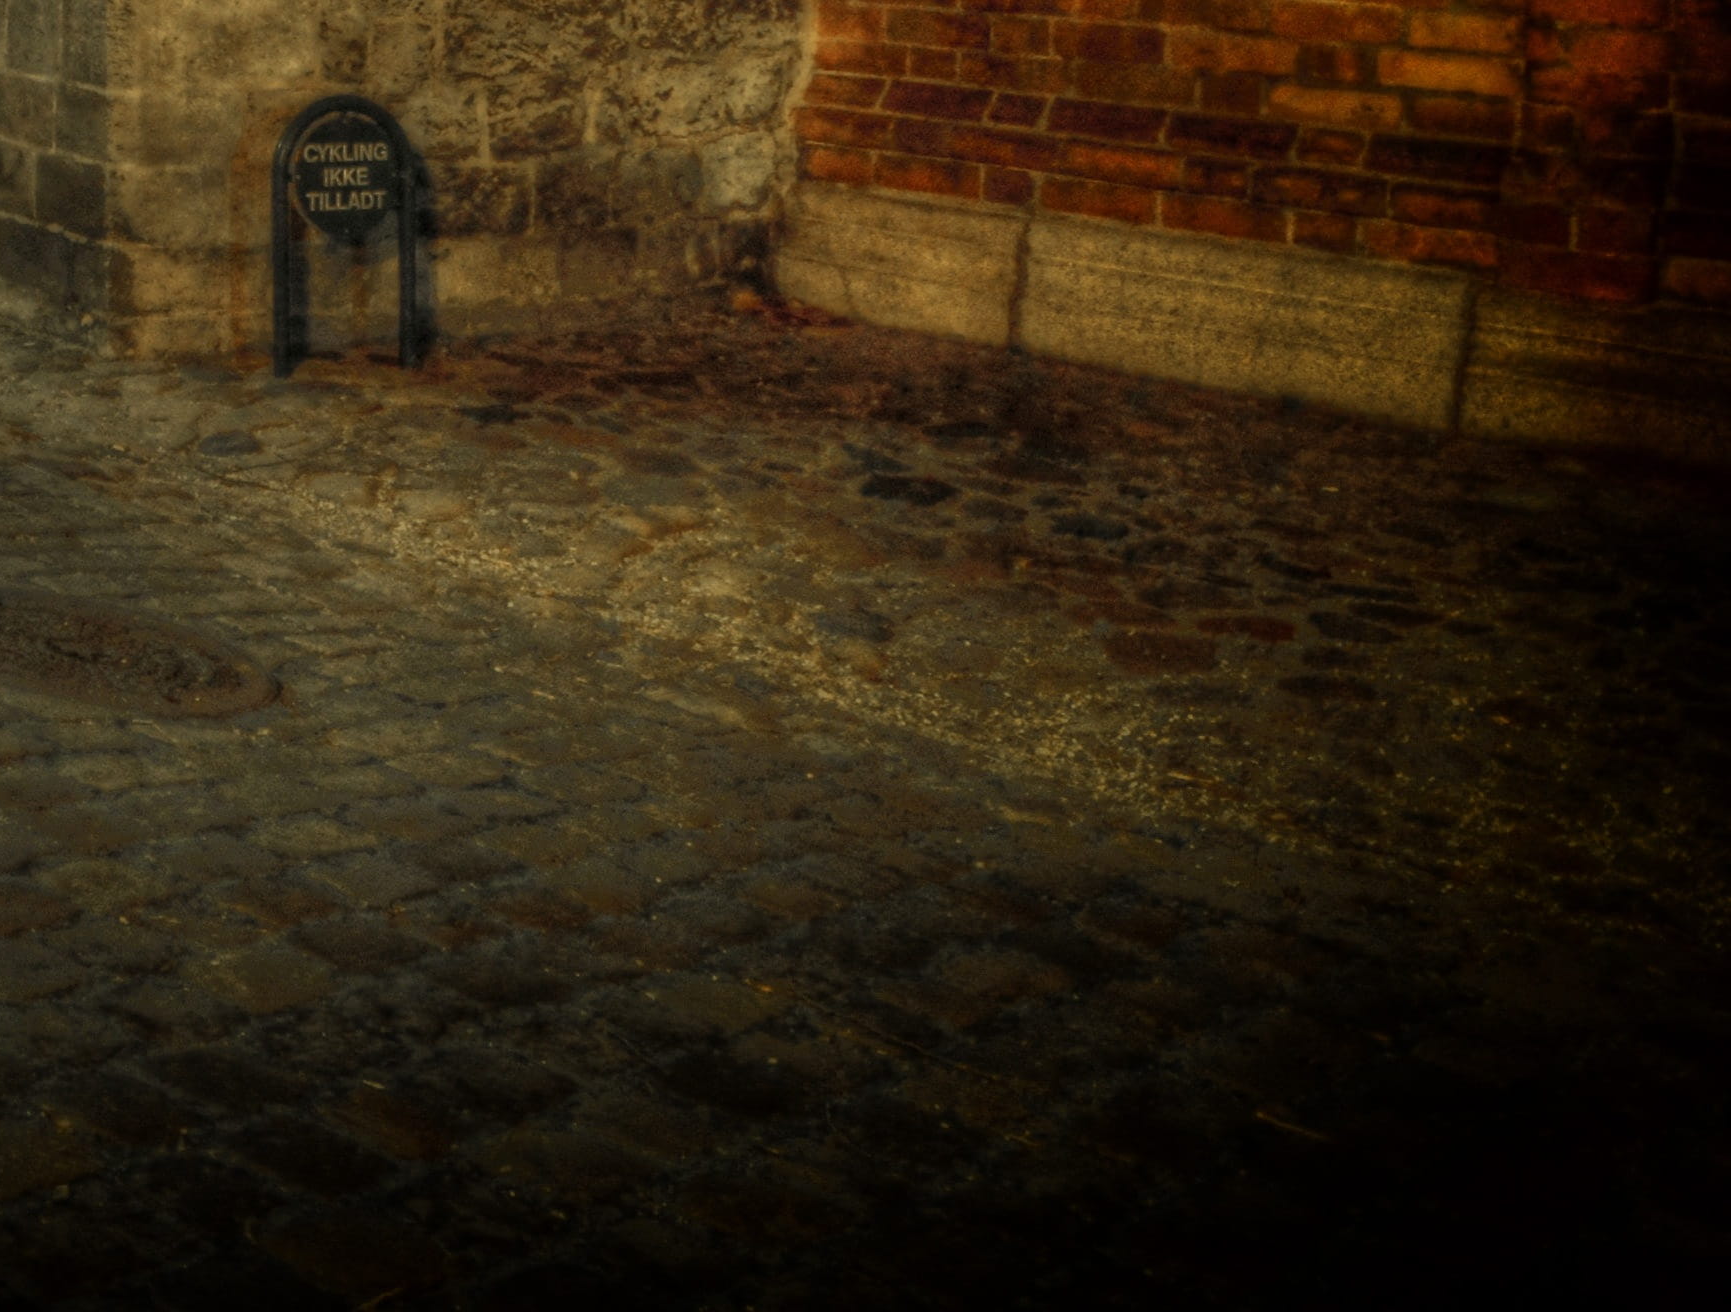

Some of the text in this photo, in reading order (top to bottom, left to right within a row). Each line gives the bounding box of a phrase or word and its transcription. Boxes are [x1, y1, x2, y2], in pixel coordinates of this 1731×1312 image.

[303, 142, 389, 163] CYKLING
[323, 167, 369, 187] IKKE
[305, 190, 388, 212] TILLADT
